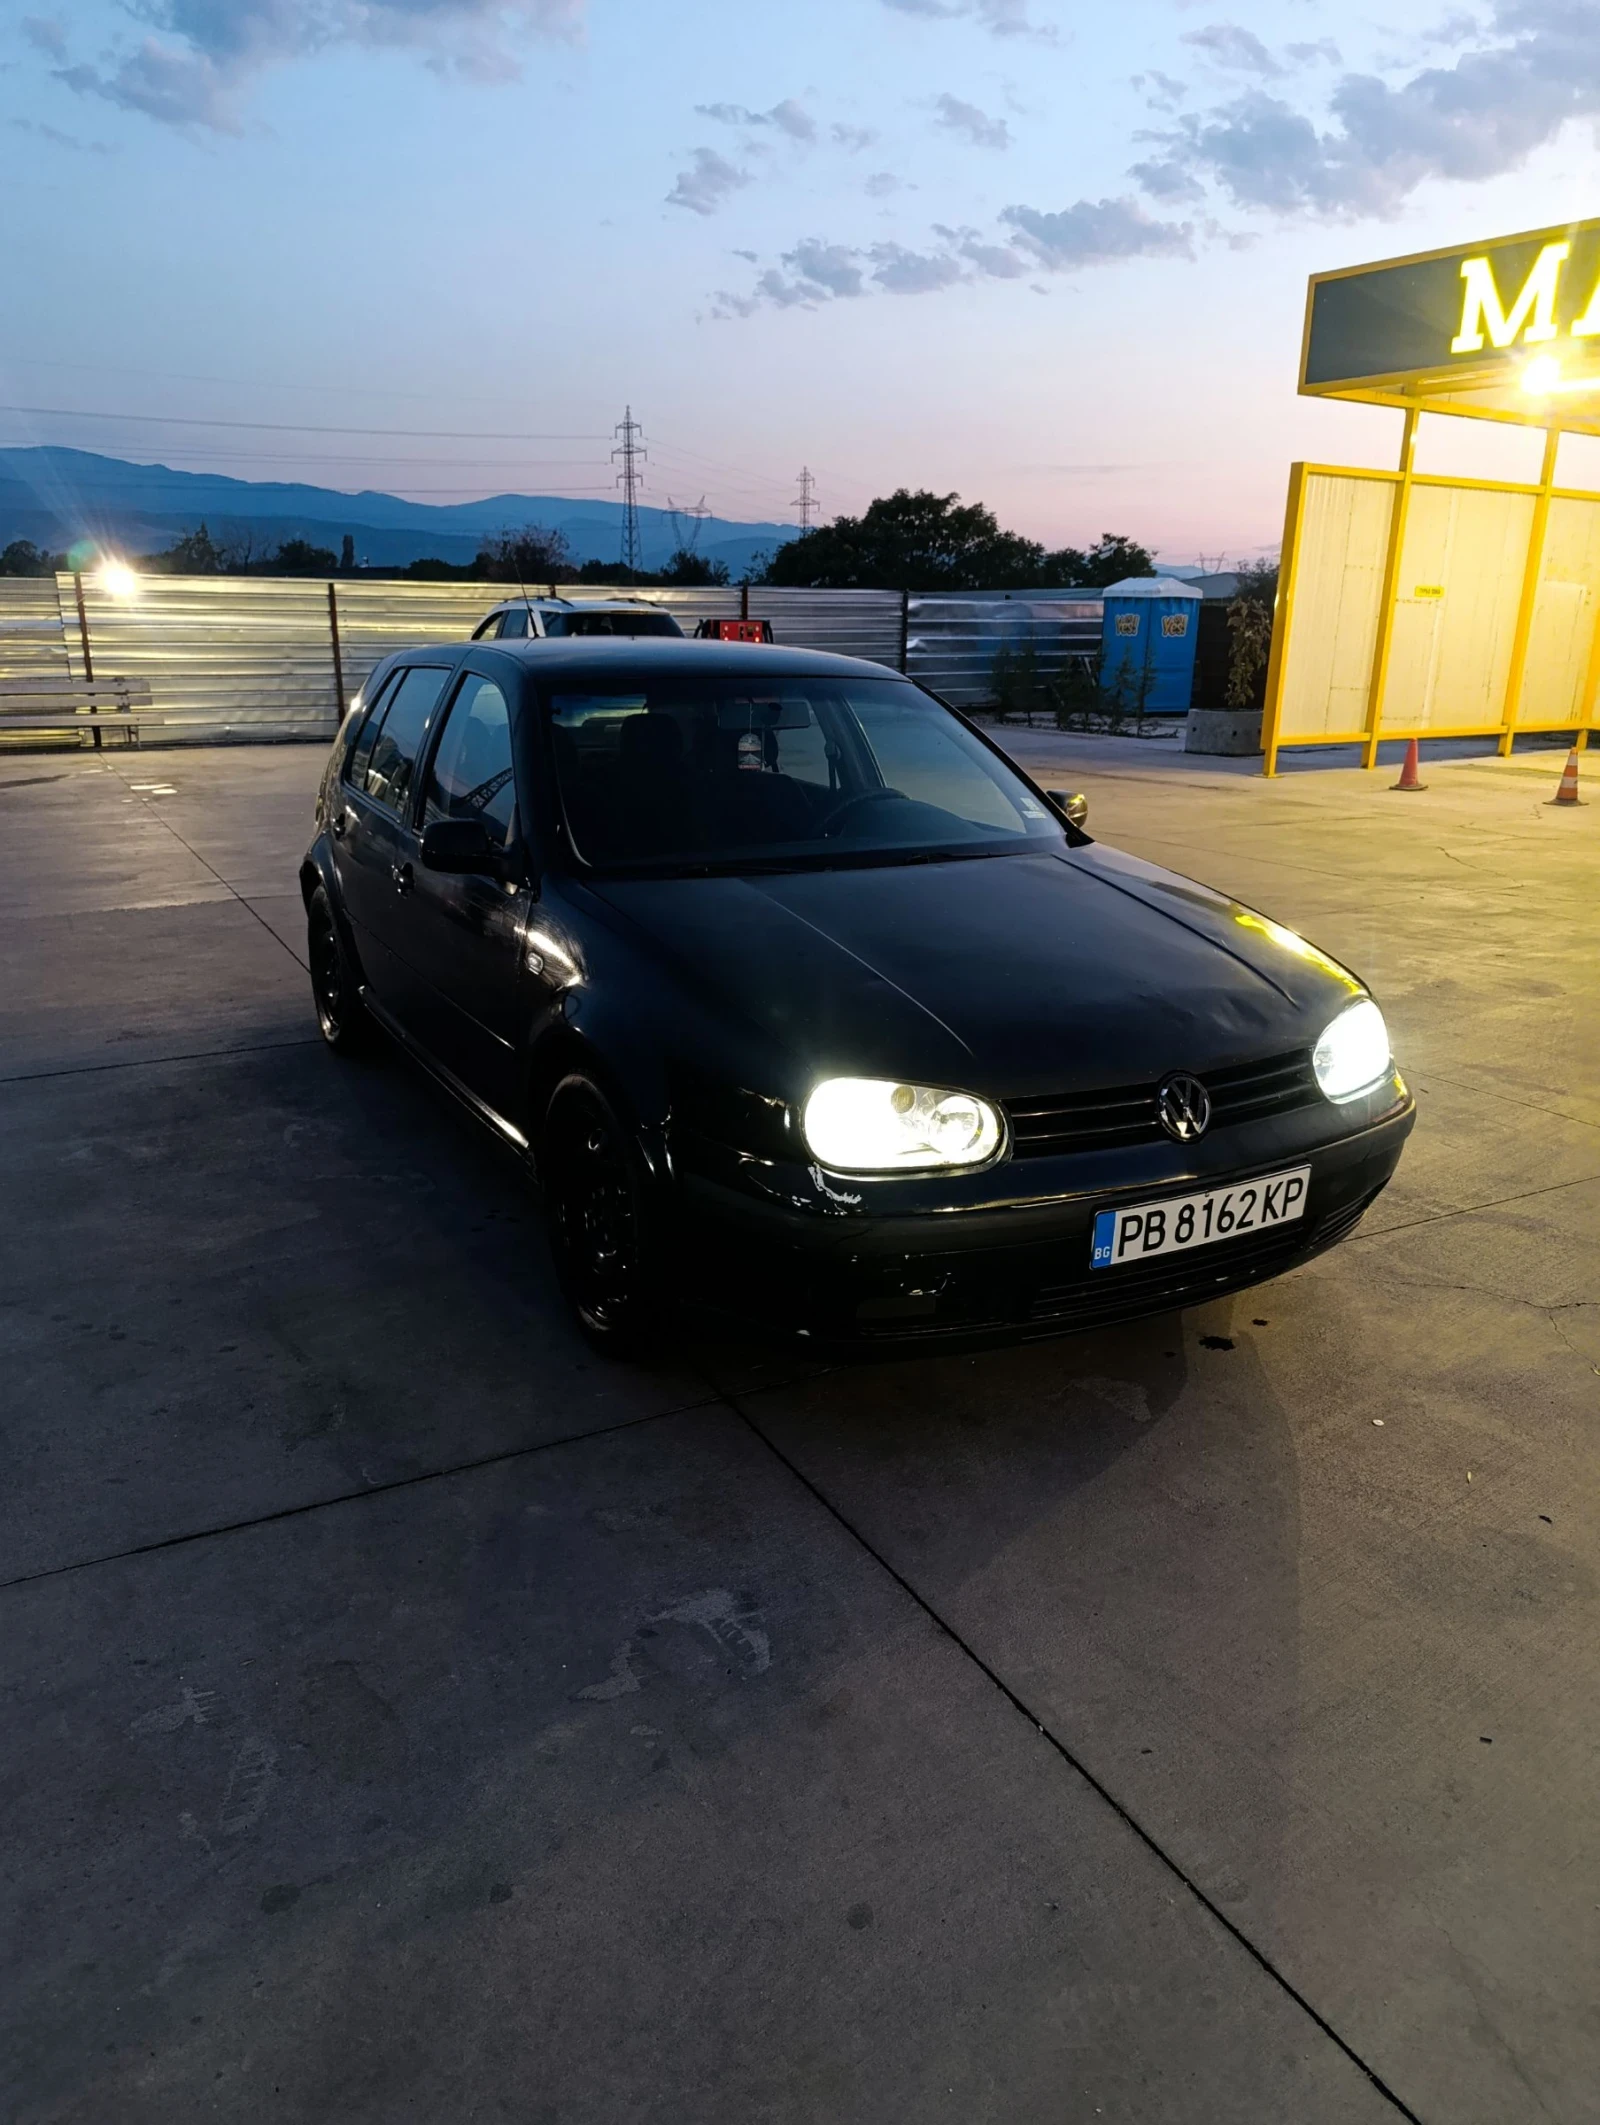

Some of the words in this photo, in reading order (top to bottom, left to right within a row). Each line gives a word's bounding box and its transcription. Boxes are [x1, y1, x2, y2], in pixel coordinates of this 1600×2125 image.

[1117, 1209, 1166, 1258] PB
[1174, 1189, 1258, 1244] 8162
[1260, 1177, 1304, 1223] KP
[1093, 1246, 1111, 1260] BG
